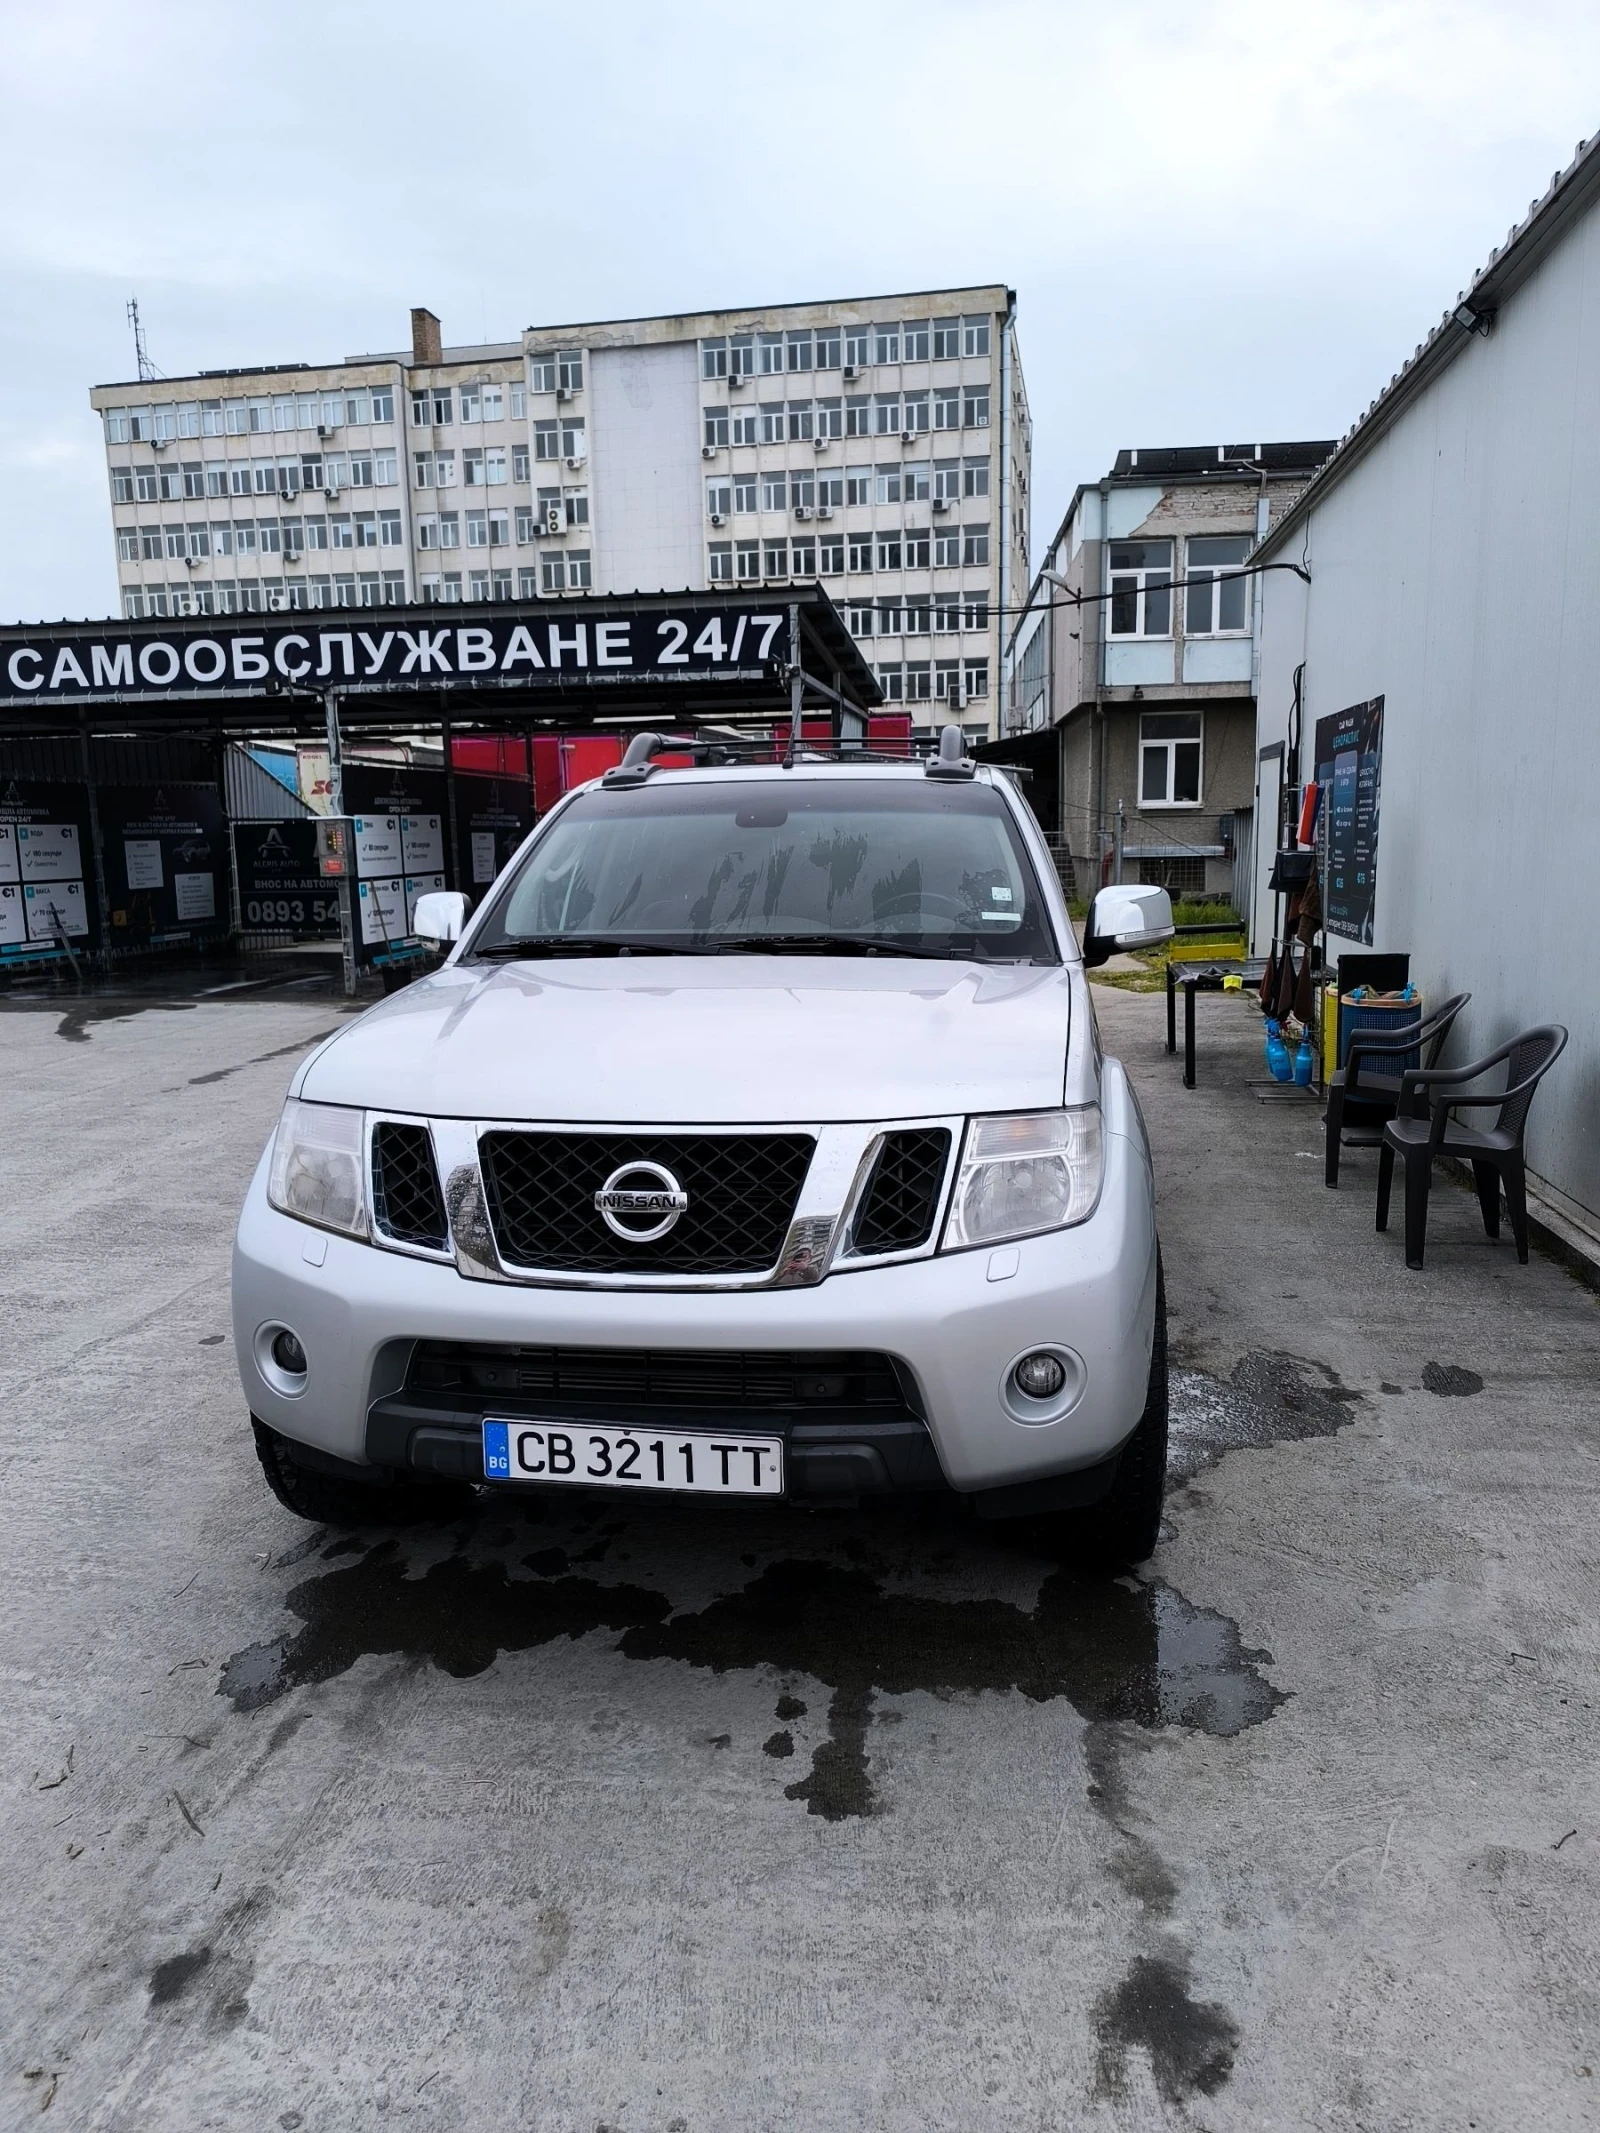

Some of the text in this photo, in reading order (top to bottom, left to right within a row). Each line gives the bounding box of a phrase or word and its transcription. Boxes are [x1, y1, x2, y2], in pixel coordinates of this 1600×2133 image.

[8, 614, 784, 690] САМООБСЛУЖВАНЕ 24/7
[254, 879, 282, 889] ВНОС
[283, 879, 298, 888] НА
[247, 900, 305, 923] 0893
[603, 1196, 676, 1208] NISSAN
[489, 1456, 508, 1469] BG
[517, 1431, 771, 1487] CB 3211 TT
